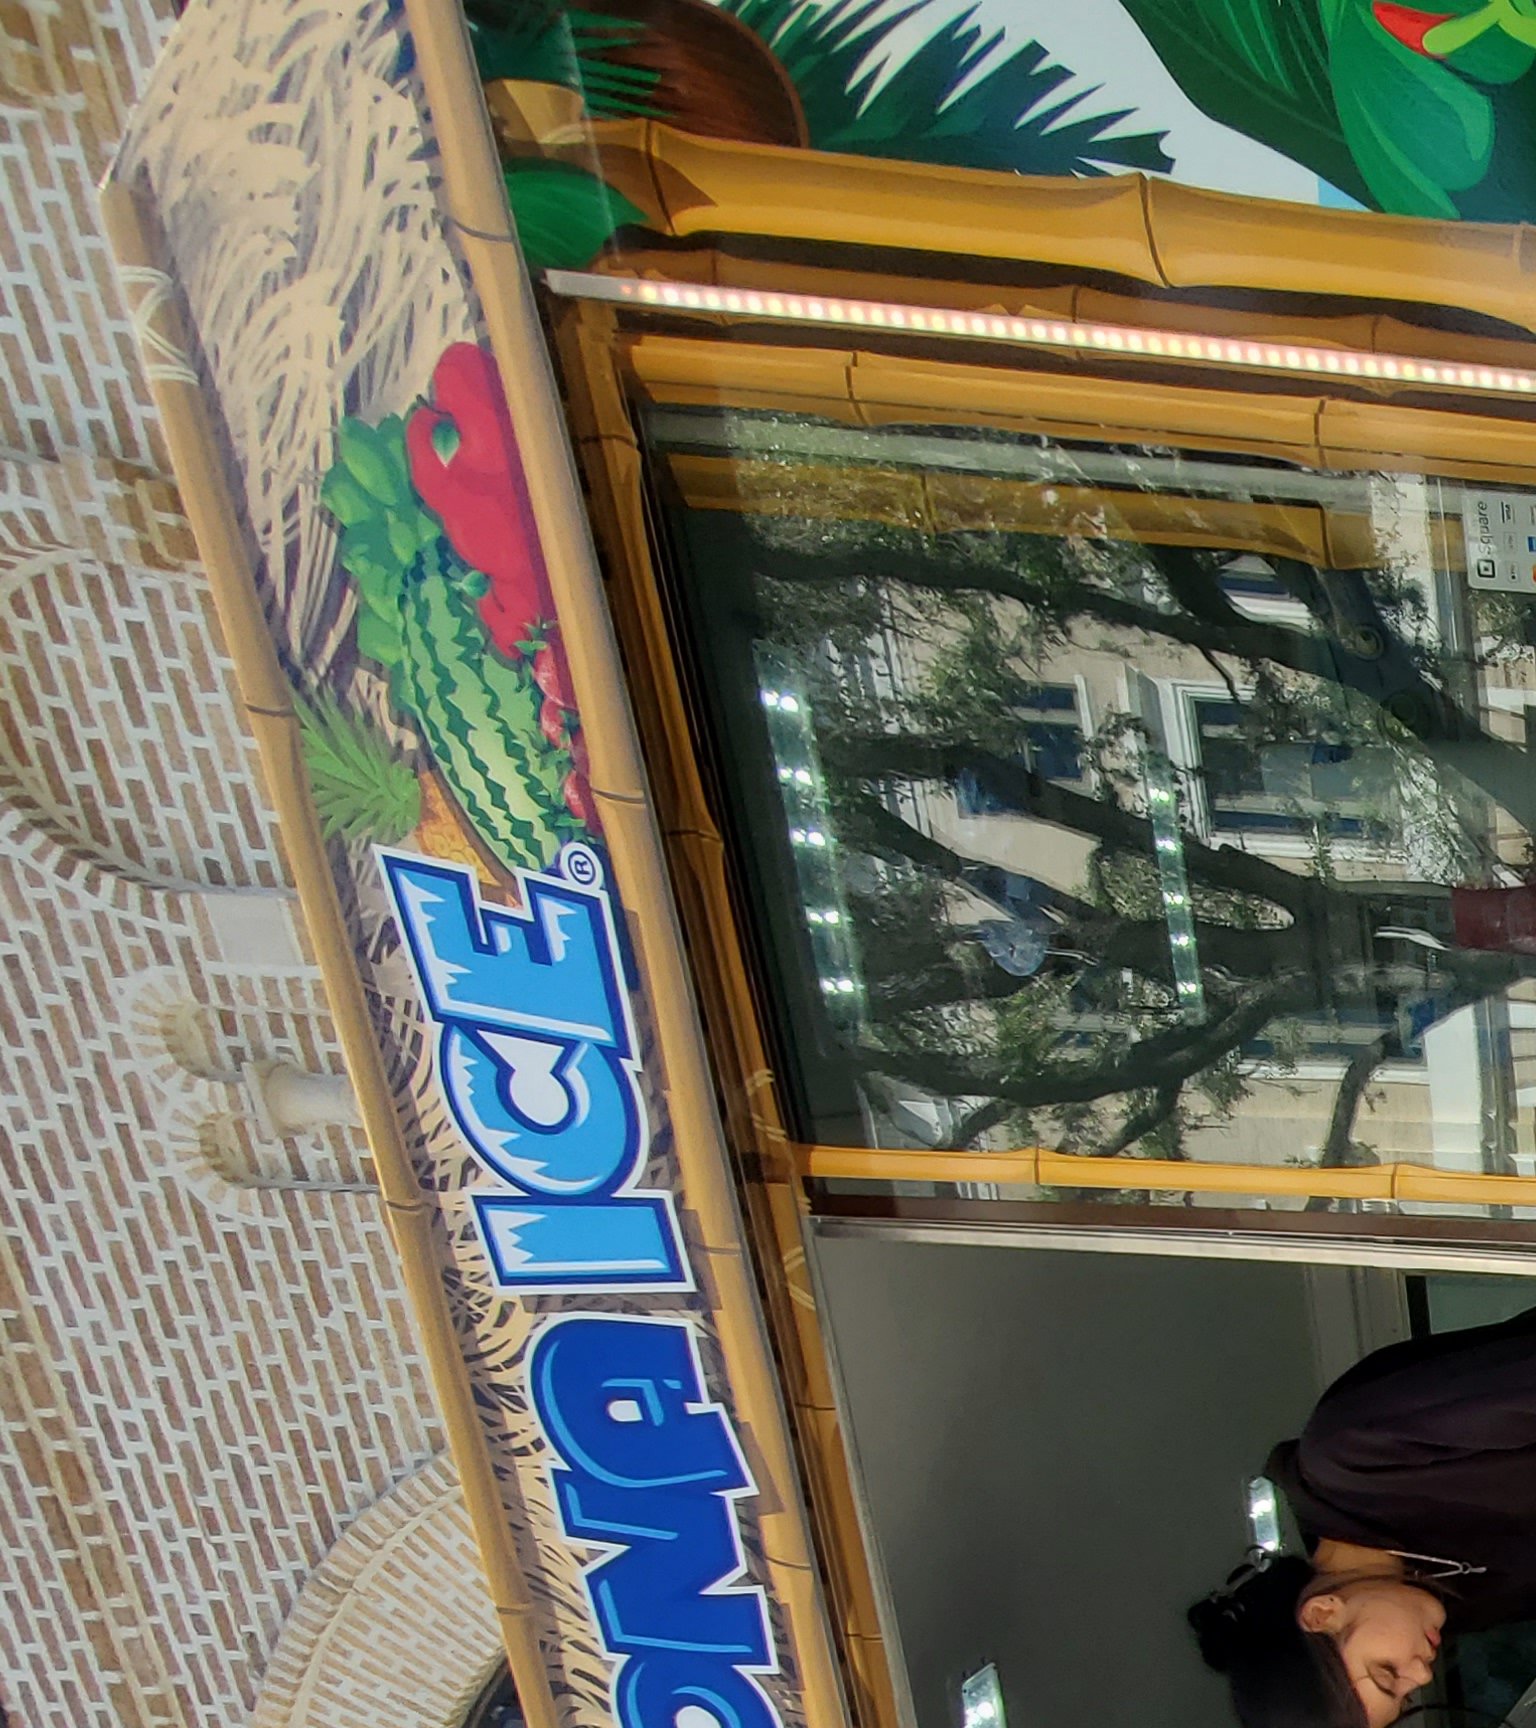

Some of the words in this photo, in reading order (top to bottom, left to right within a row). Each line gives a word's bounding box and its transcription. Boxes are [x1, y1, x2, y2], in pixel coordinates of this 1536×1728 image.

[1477, 501, 1493, 555] Square
[1504, 504, 1512, 521] VISA
[373, 844, 697, 1295] ICE
